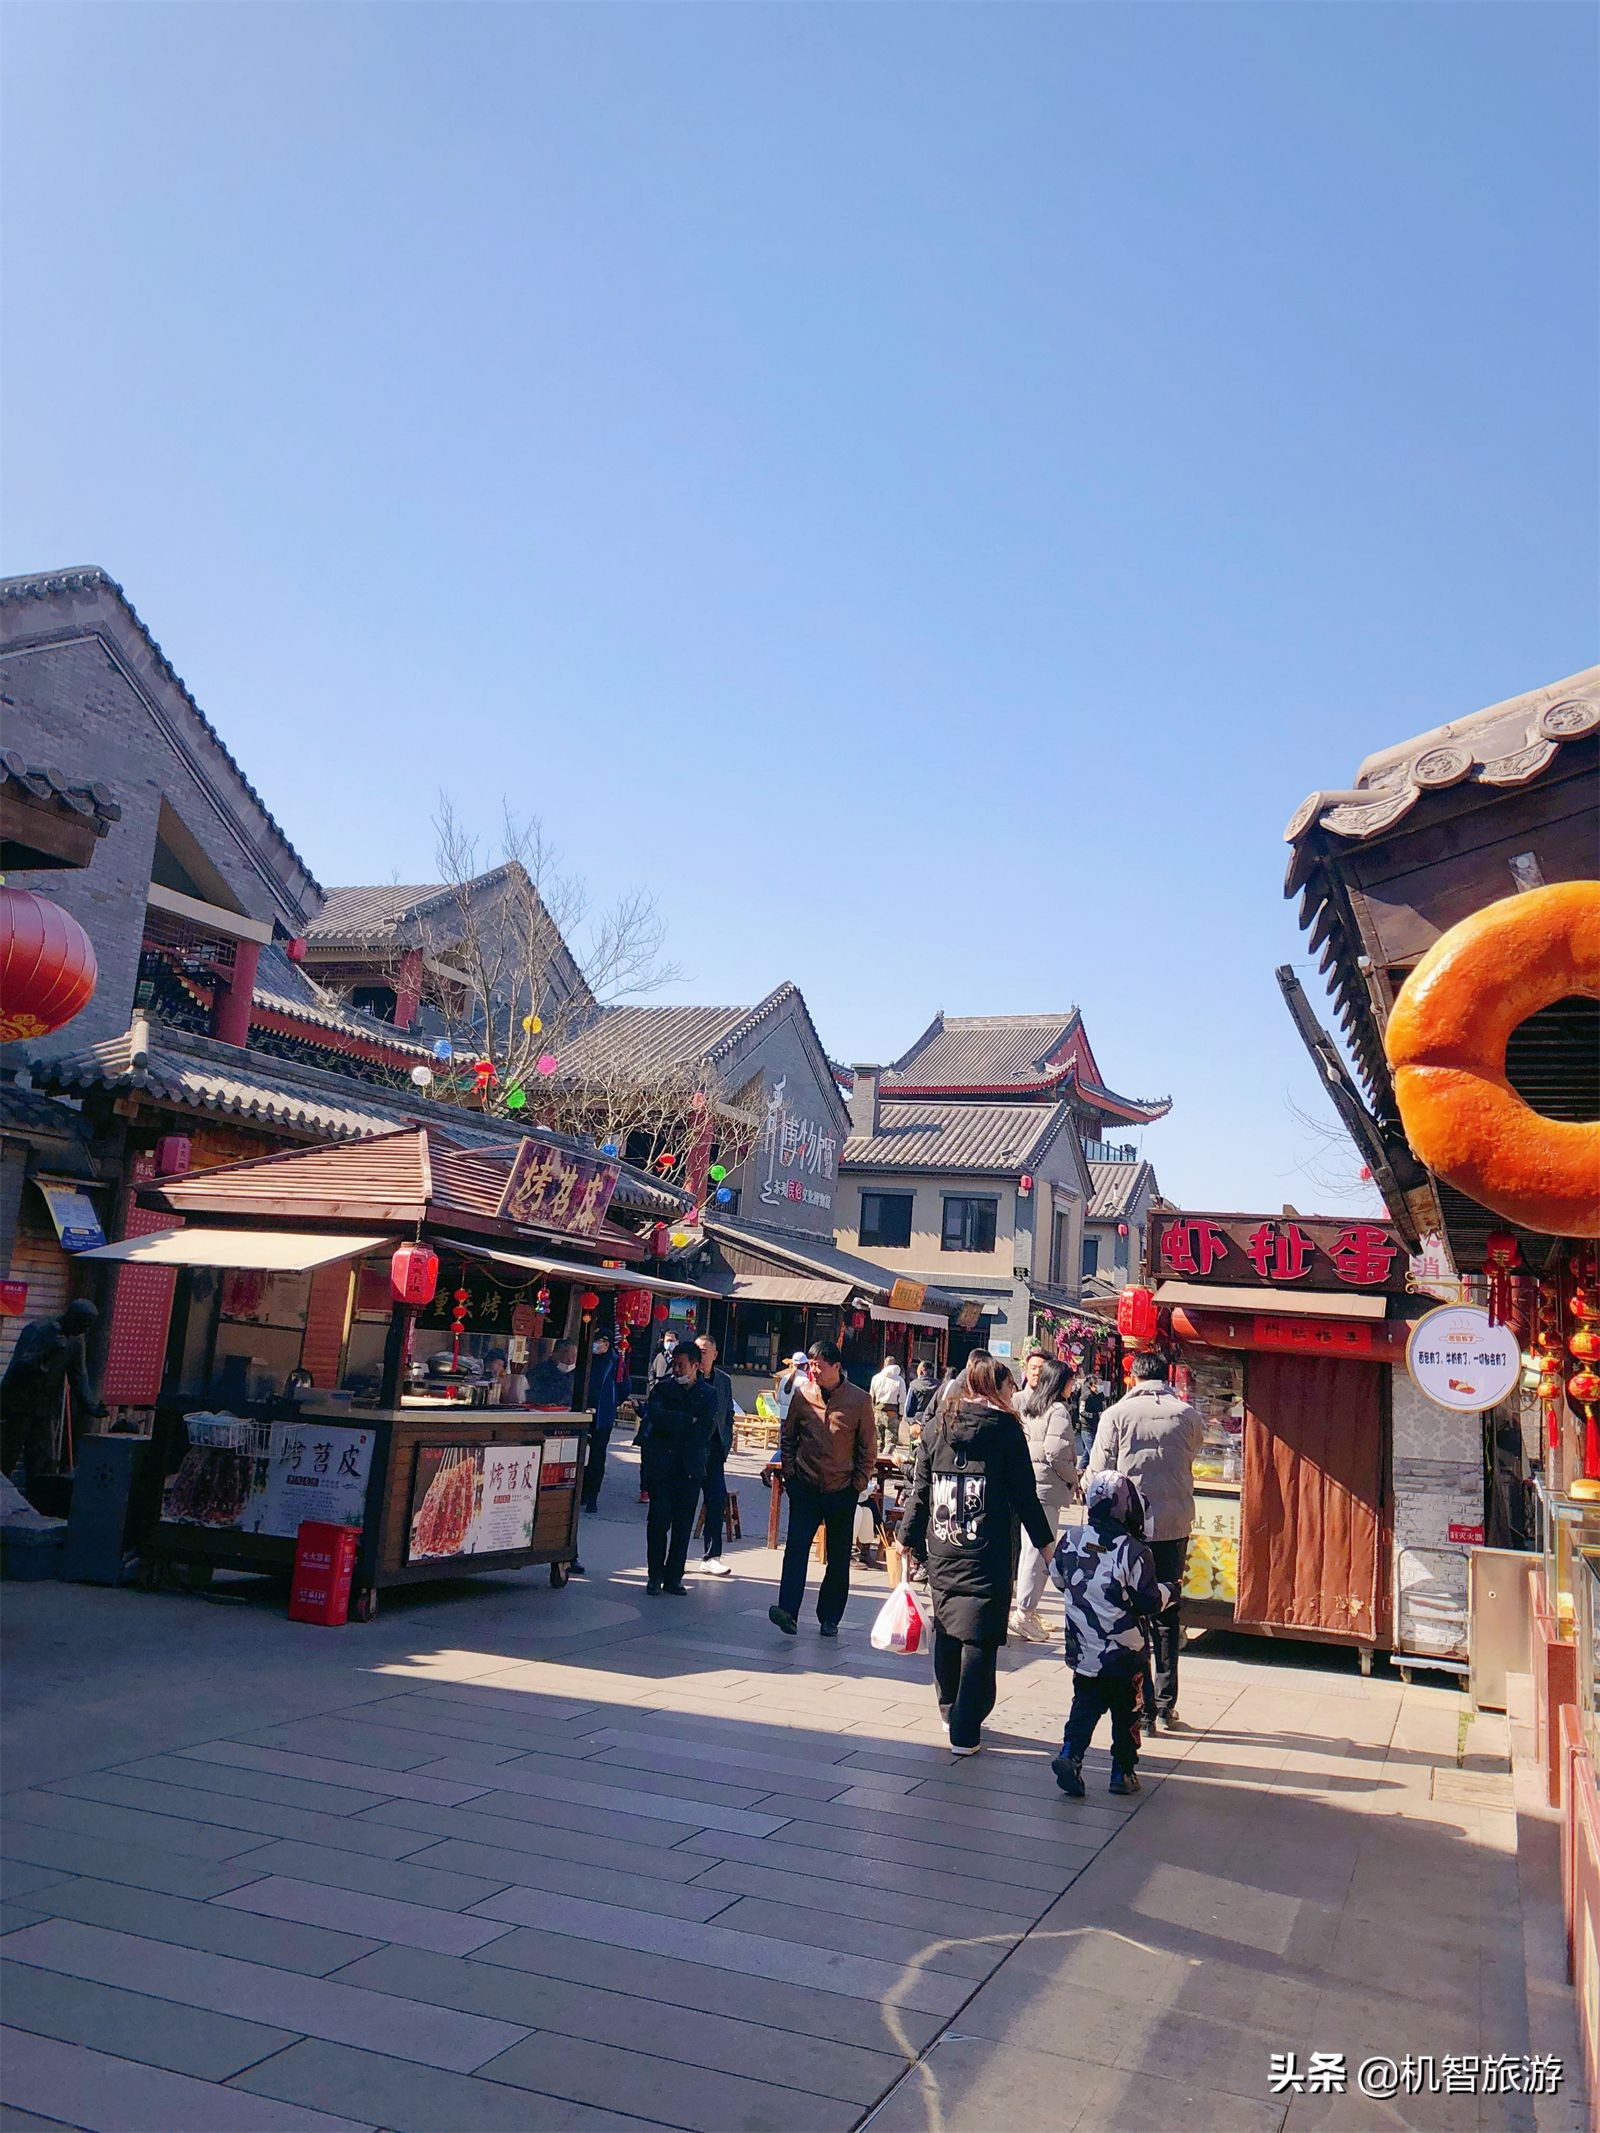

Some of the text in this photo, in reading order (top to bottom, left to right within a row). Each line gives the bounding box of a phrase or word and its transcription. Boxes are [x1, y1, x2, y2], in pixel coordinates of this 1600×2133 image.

[514, 1151, 604, 1234] 烤苕皮
[1160, 1219, 1397, 1284] 虾扯蛋
[280, 1438, 361, 1477] 烤苕皮
[489, 1460, 532, 1490] 烤苕皮
